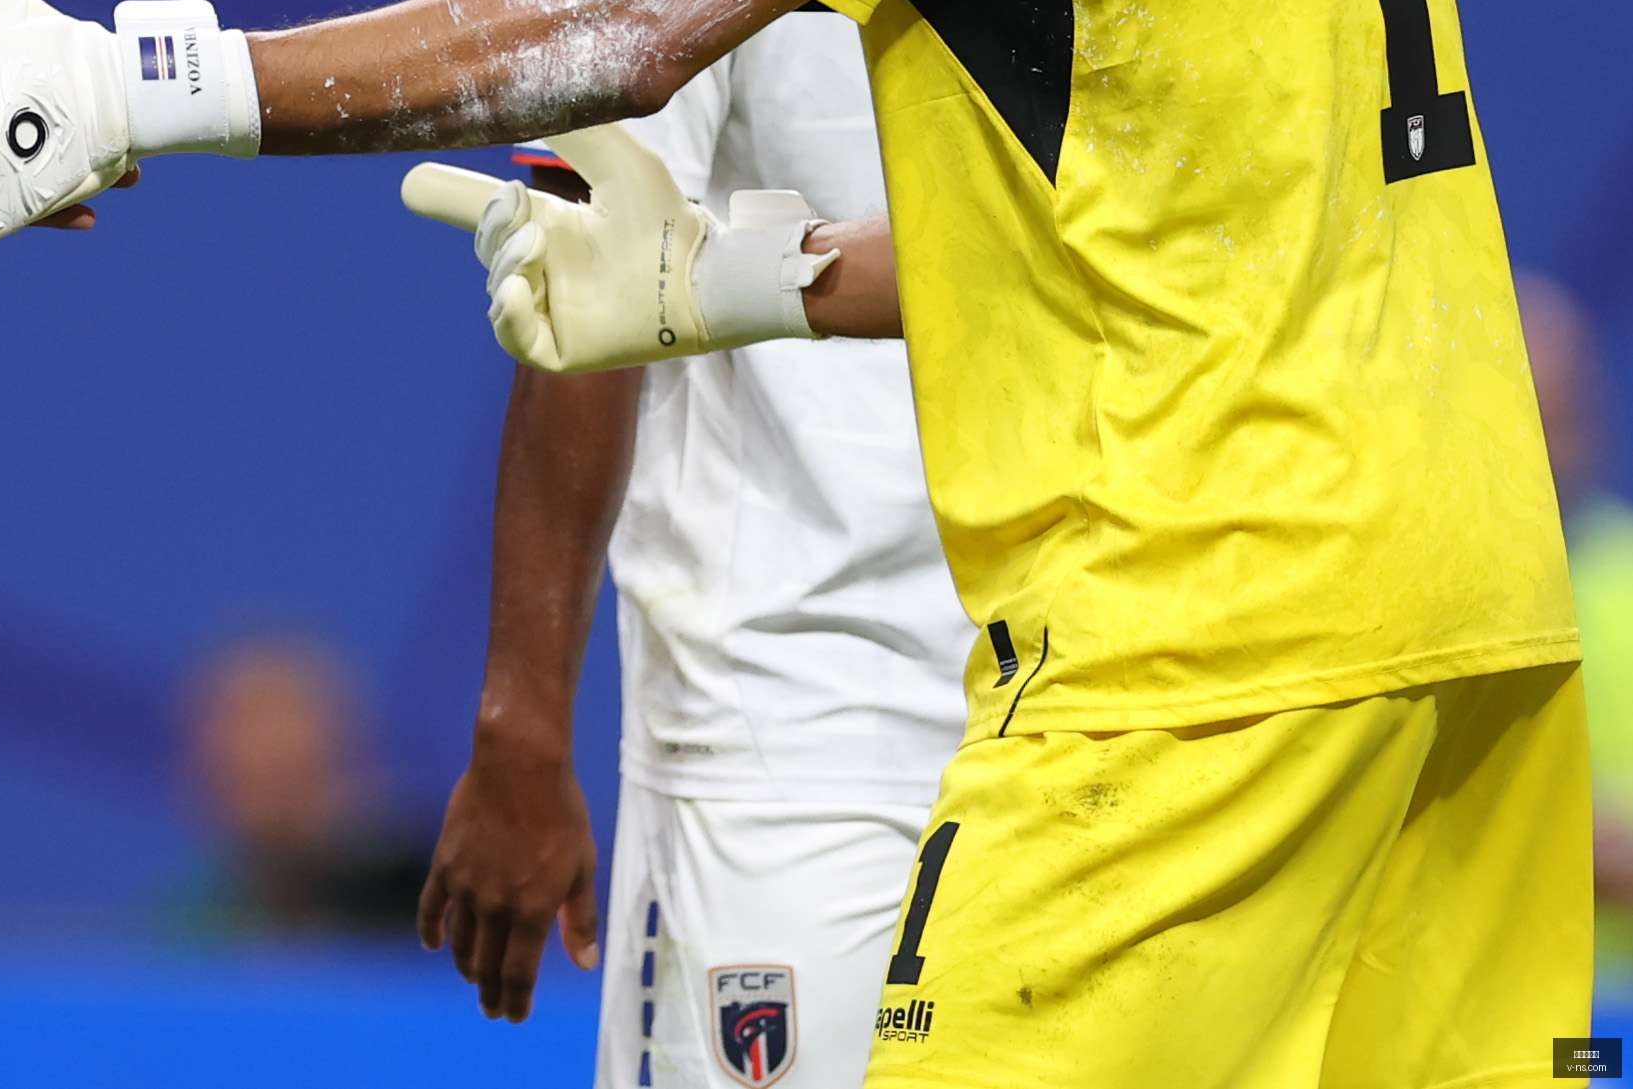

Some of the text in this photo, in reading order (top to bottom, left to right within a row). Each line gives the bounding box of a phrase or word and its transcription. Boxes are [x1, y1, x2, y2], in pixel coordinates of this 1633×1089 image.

[886, 821, 960, 985] 1
[717, 972, 785, 992] FCF
[882, 1030, 930, 1044] SPORT
